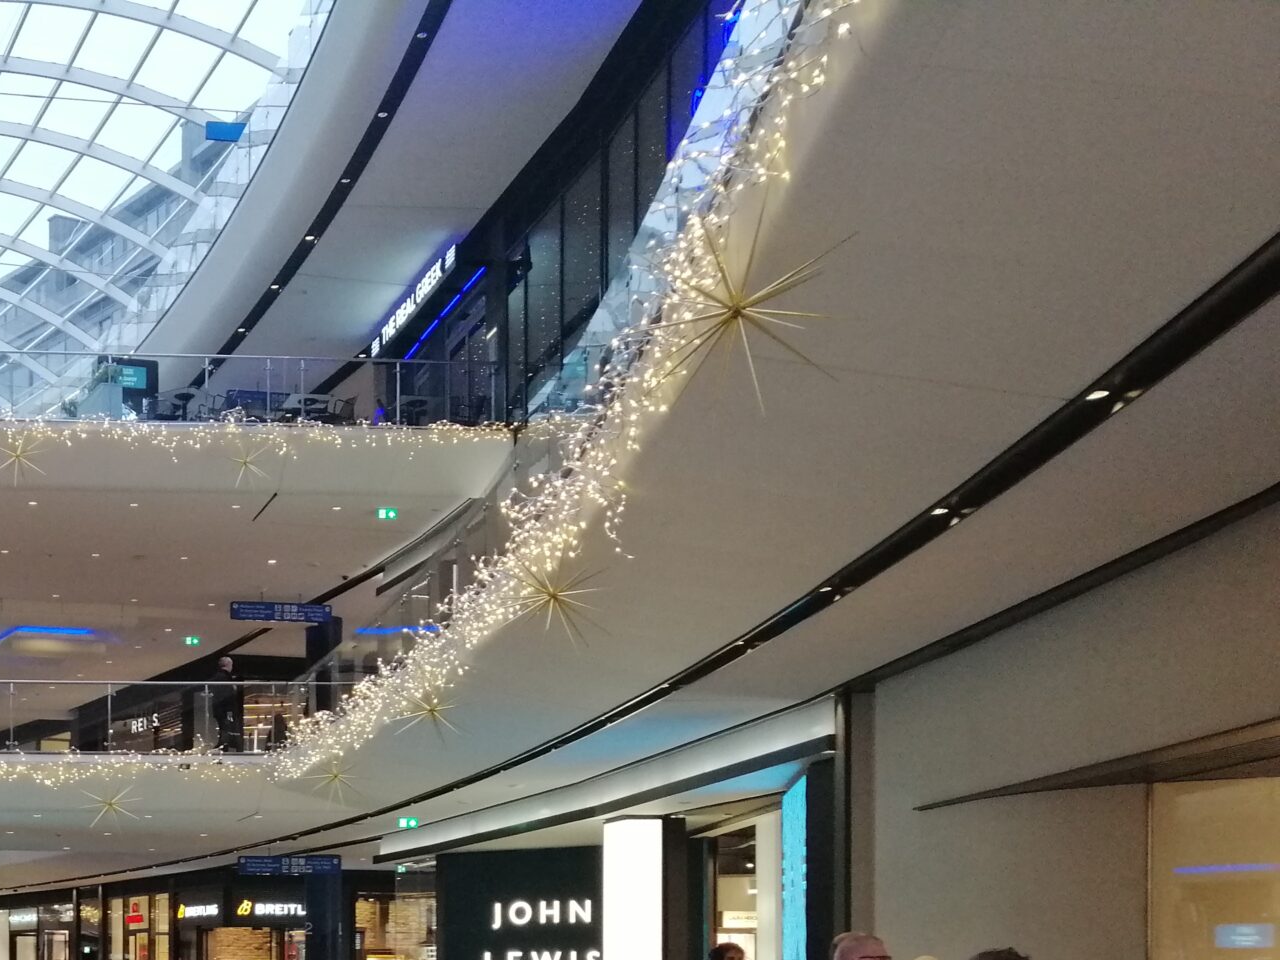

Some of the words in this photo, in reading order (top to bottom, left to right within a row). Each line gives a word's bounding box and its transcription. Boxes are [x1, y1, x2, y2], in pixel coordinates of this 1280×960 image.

[381, 315, 396, 345] THE
[395, 293, 416, 329] REAL
[415, 257, 442, 304] GREEK
[491, 898, 592, 931] JOHN
